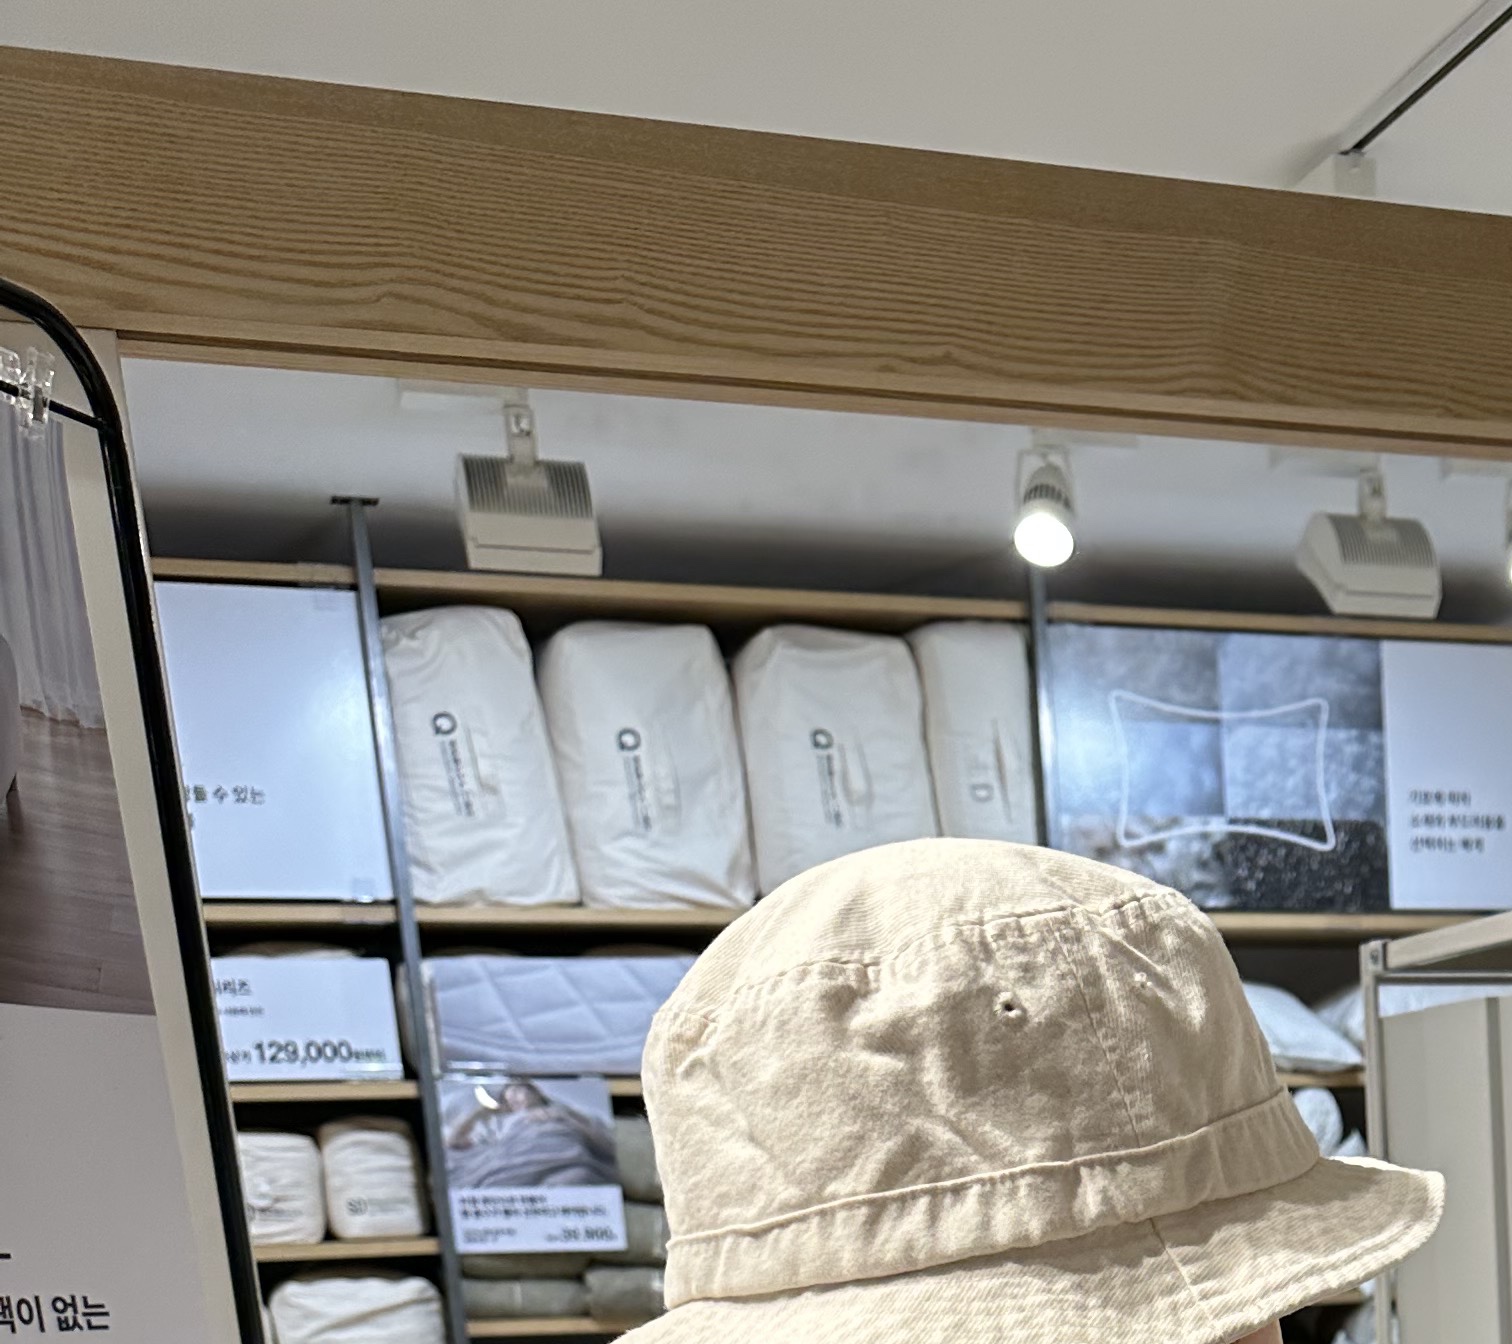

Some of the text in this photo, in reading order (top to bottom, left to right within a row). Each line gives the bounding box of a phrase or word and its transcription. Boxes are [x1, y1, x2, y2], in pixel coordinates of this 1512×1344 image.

[212, 784, 229, 805] 수
[231, 784, 266, 806] 있는
[51, 1294, 110, 1333] 없는
